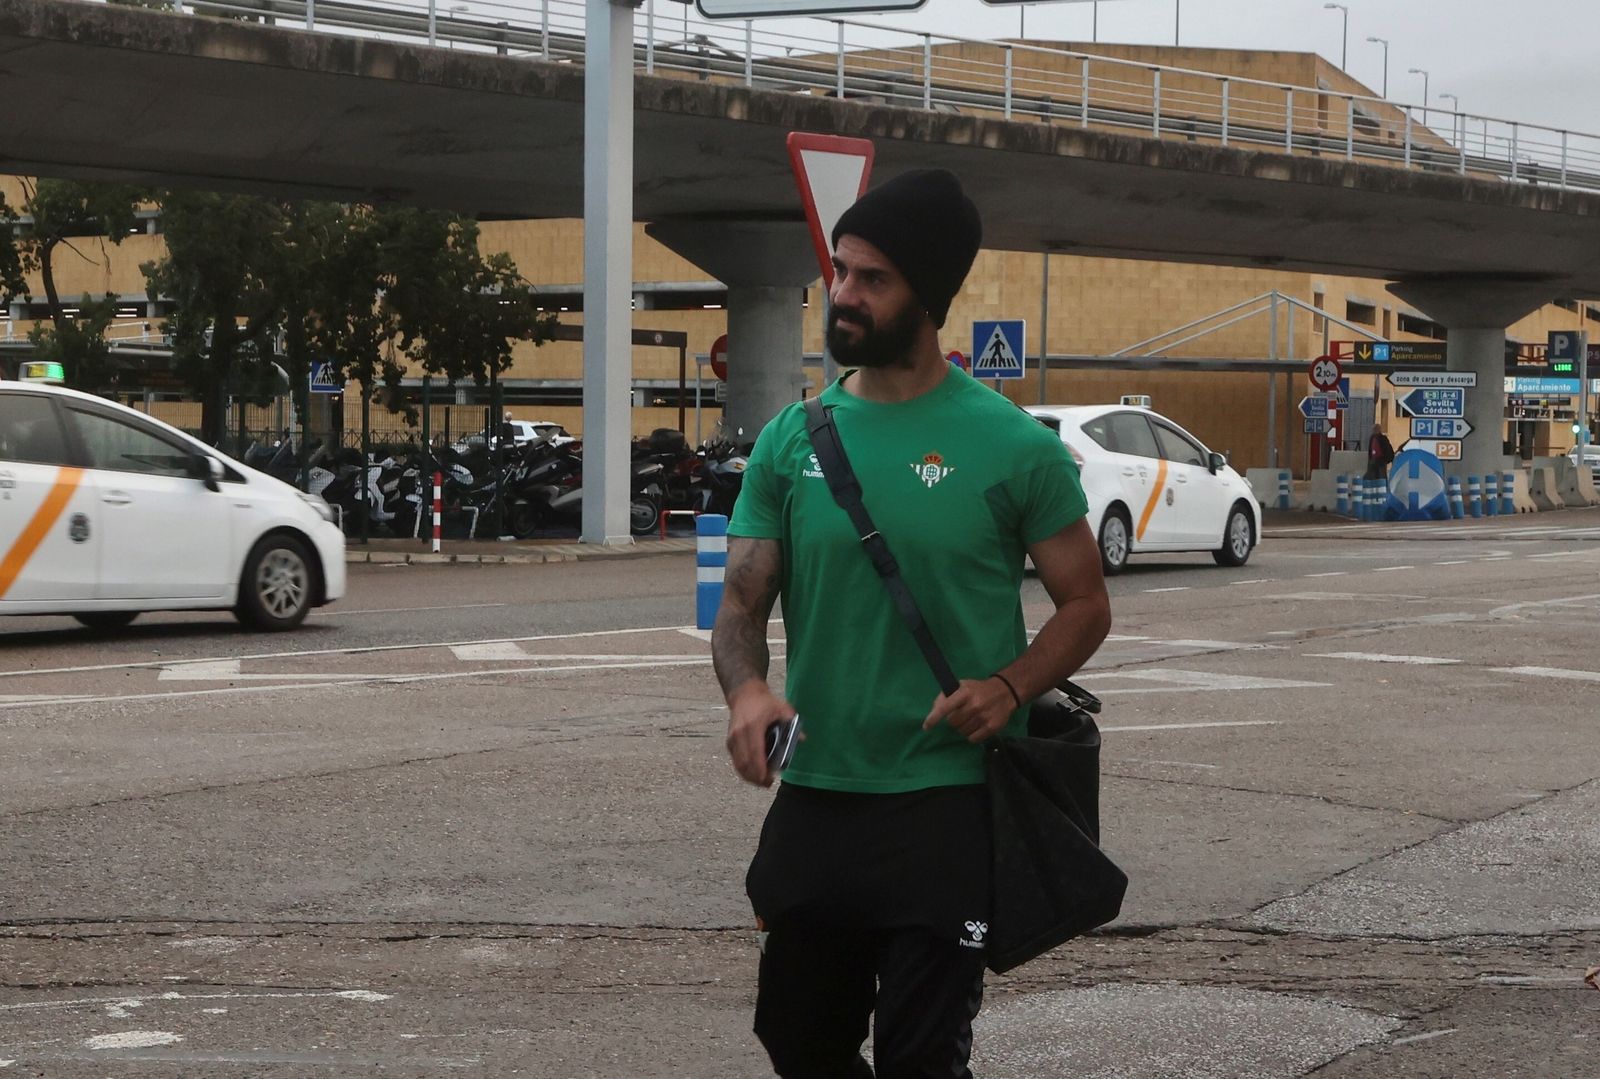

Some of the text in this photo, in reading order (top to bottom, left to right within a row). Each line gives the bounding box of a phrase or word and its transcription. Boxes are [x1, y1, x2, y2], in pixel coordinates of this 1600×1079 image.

[1554, 334, 1569, 356] P
[1374, 347, 1388, 357] P1
[1391, 352, 1442, 361] Aparcamiento
[1412, 375, 1420, 383] de
[1421, 376, 1439, 384] carga
[1447, 375, 1474, 384] descarga
[1517, 383, 1571, 393] Aparcamiento
[1426, 399, 1455, 407] Sevilla
[1422, 406, 1457, 414] Córdoba
[1416, 421, 1432, 434] P1
[1438, 444, 1457, 456] P2
